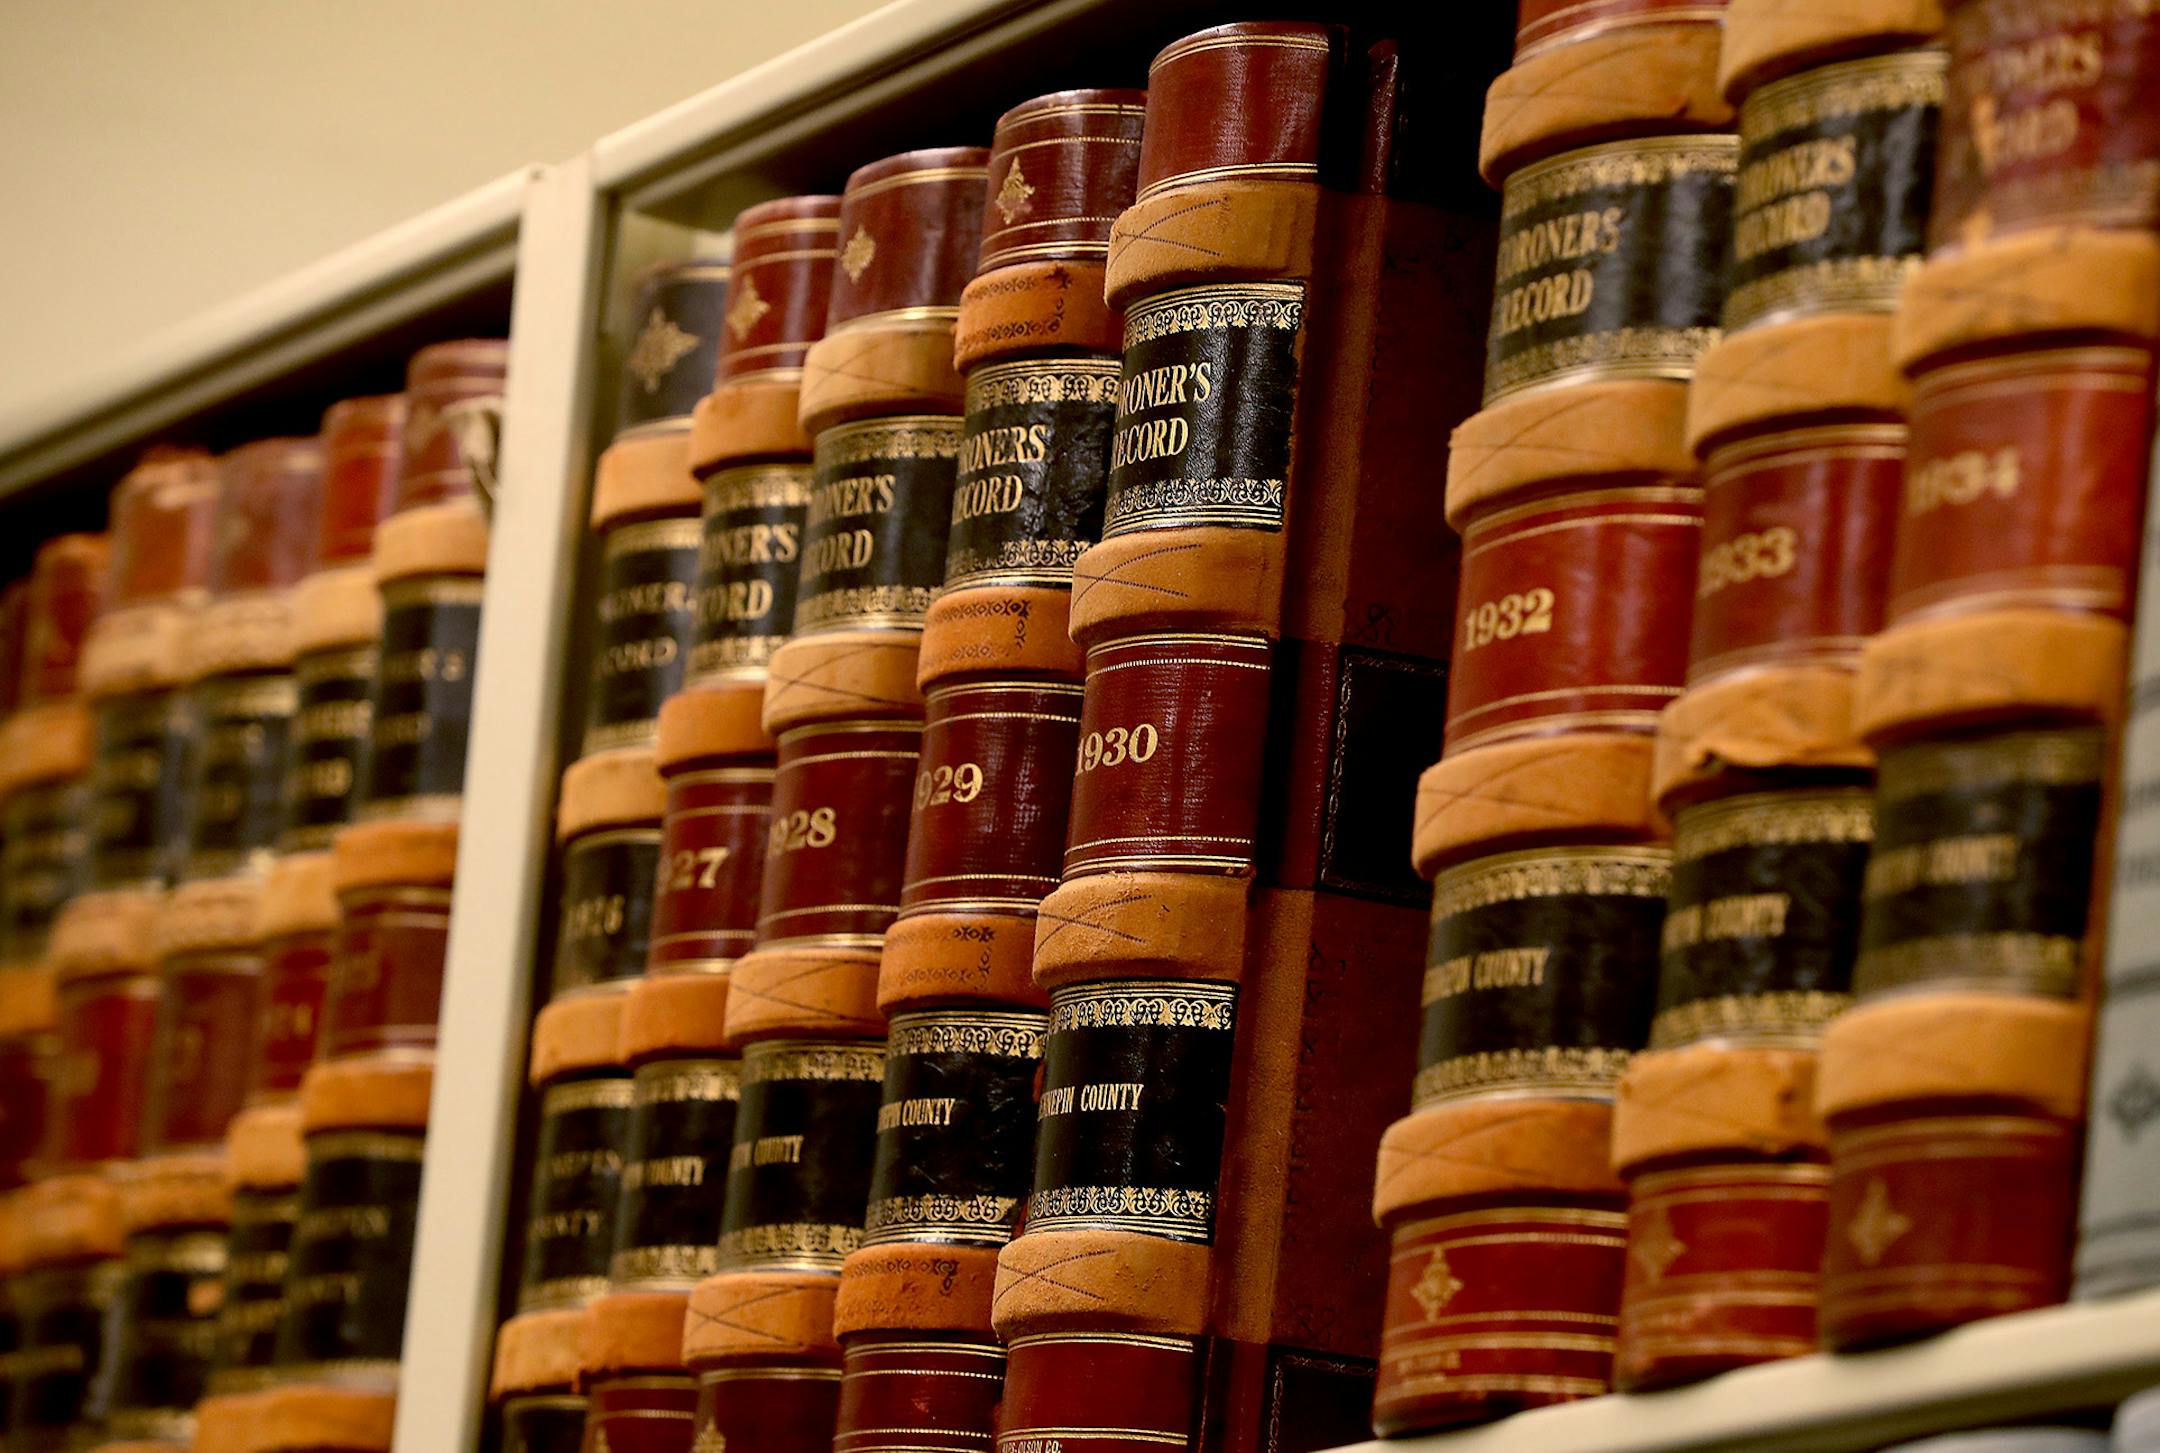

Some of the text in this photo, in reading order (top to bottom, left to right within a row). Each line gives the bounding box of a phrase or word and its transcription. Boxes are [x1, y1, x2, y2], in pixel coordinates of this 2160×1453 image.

[1115, 362, 1212, 423] RONER'S
[1464, 588, 1555, 653] 1932
[1075, 724, 1158, 777] 1930
[902, 1097, 957, 1127] COUNTY
[1080, 1083, 1145, 1112] COUNTY
